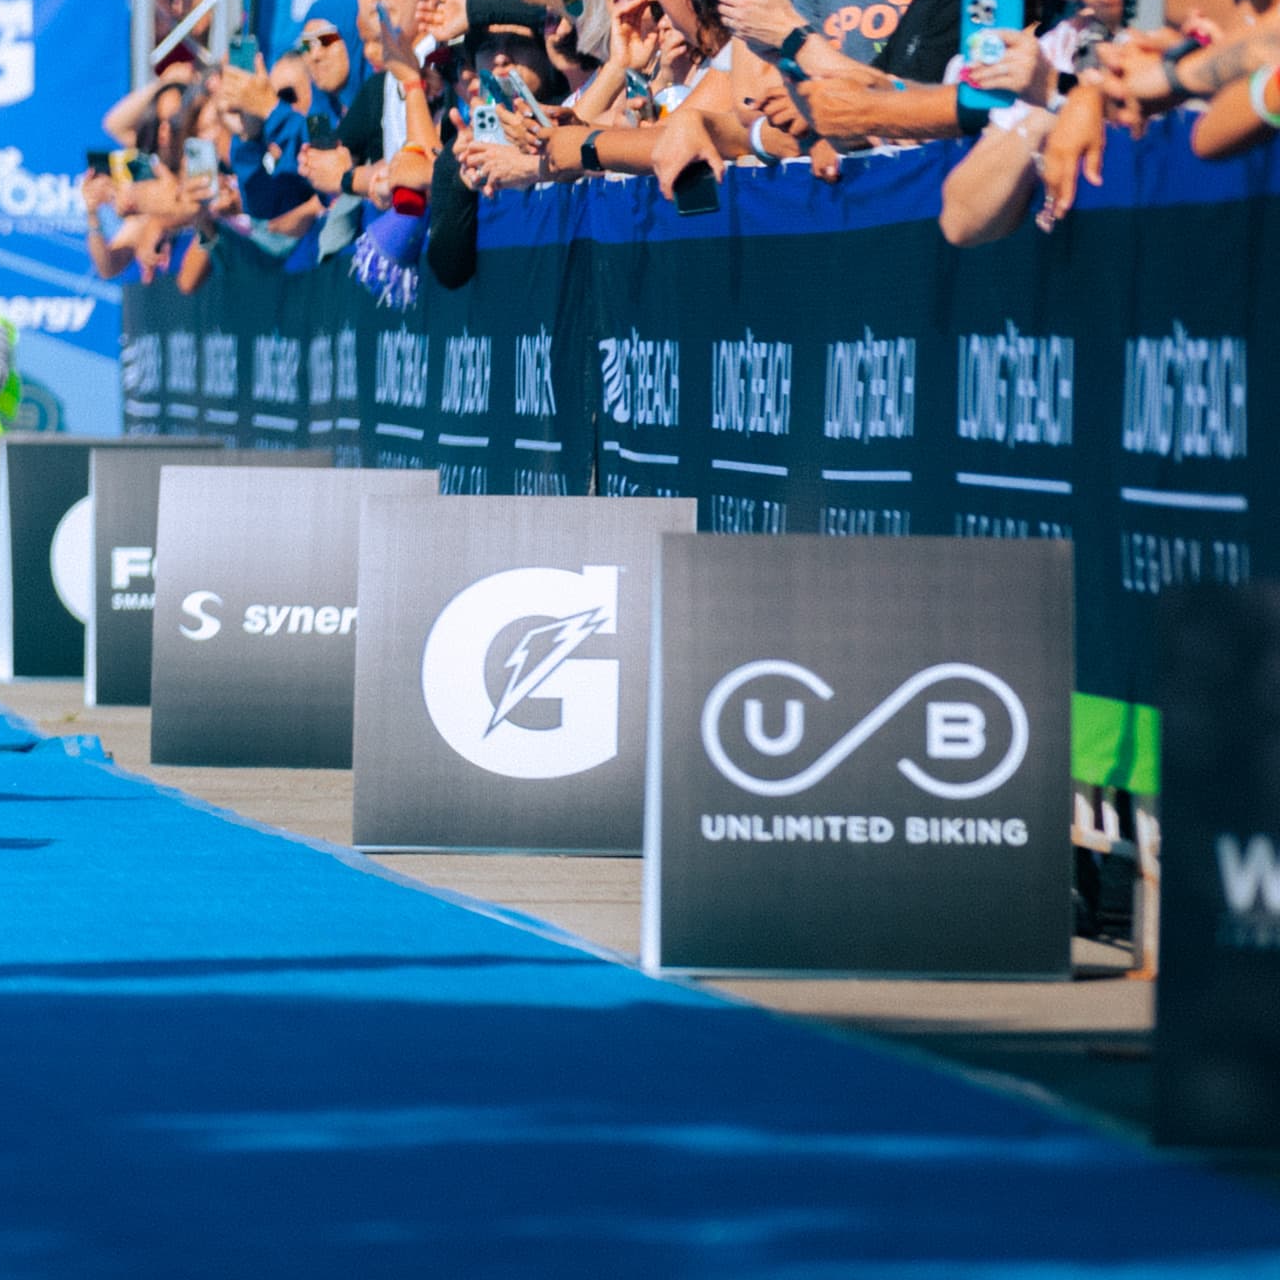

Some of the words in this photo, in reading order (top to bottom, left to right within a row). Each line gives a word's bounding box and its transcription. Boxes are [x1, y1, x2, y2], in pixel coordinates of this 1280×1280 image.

[638, 339, 680, 427] BEACH
[422, 564, 621, 779] G
[743, 698, 805, 757] U
[926, 701, 987, 760] B
[700, 813, 895, 843] UNLIMITED
[904, 816, 1029, 847] BIKING
